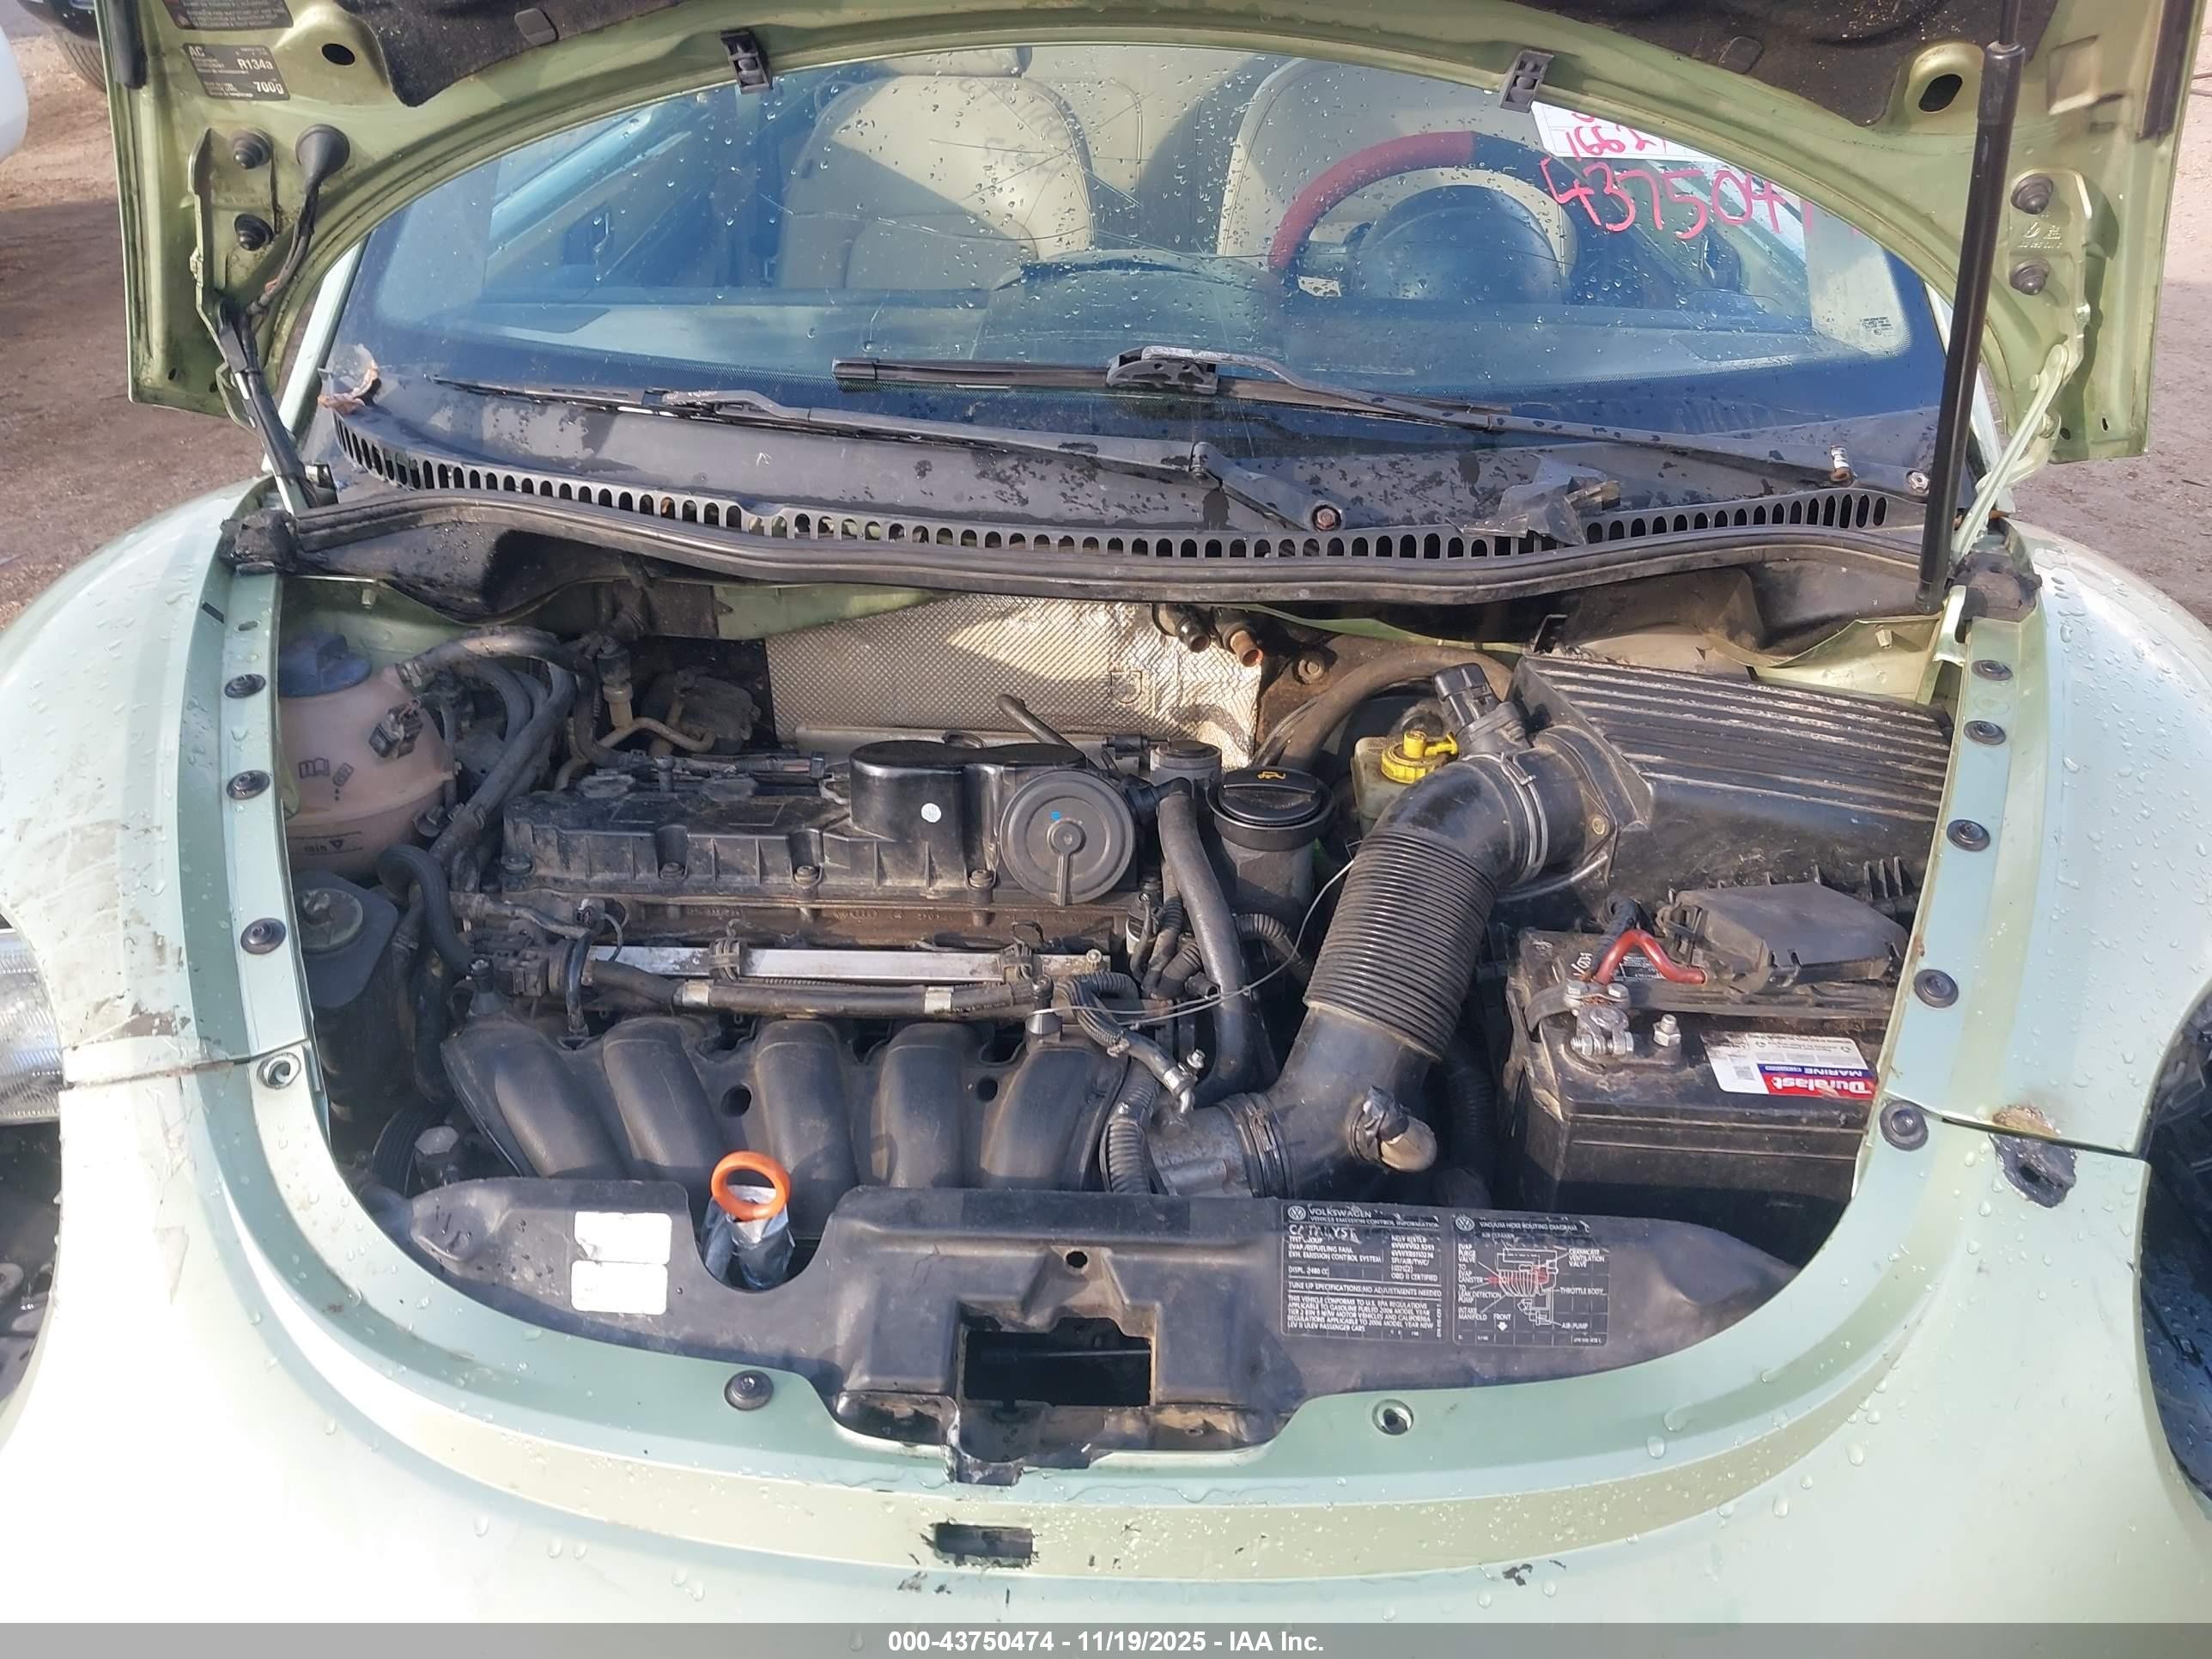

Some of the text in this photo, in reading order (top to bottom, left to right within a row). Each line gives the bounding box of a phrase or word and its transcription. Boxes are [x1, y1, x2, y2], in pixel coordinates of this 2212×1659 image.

[188, 46, 205, 57] AC
[237, 58, 274, 70] R134a
[253, 82, 285, 94] 700g
[1804, 1067, 1863, 1078] MARINE
[1771, 1076, 1873, 1095] Duralast
[1309, 1208, 1371, 1218] VOLKSWAGEN
[1374, 1286, 1417, 1296] ADJUSTMENTS
